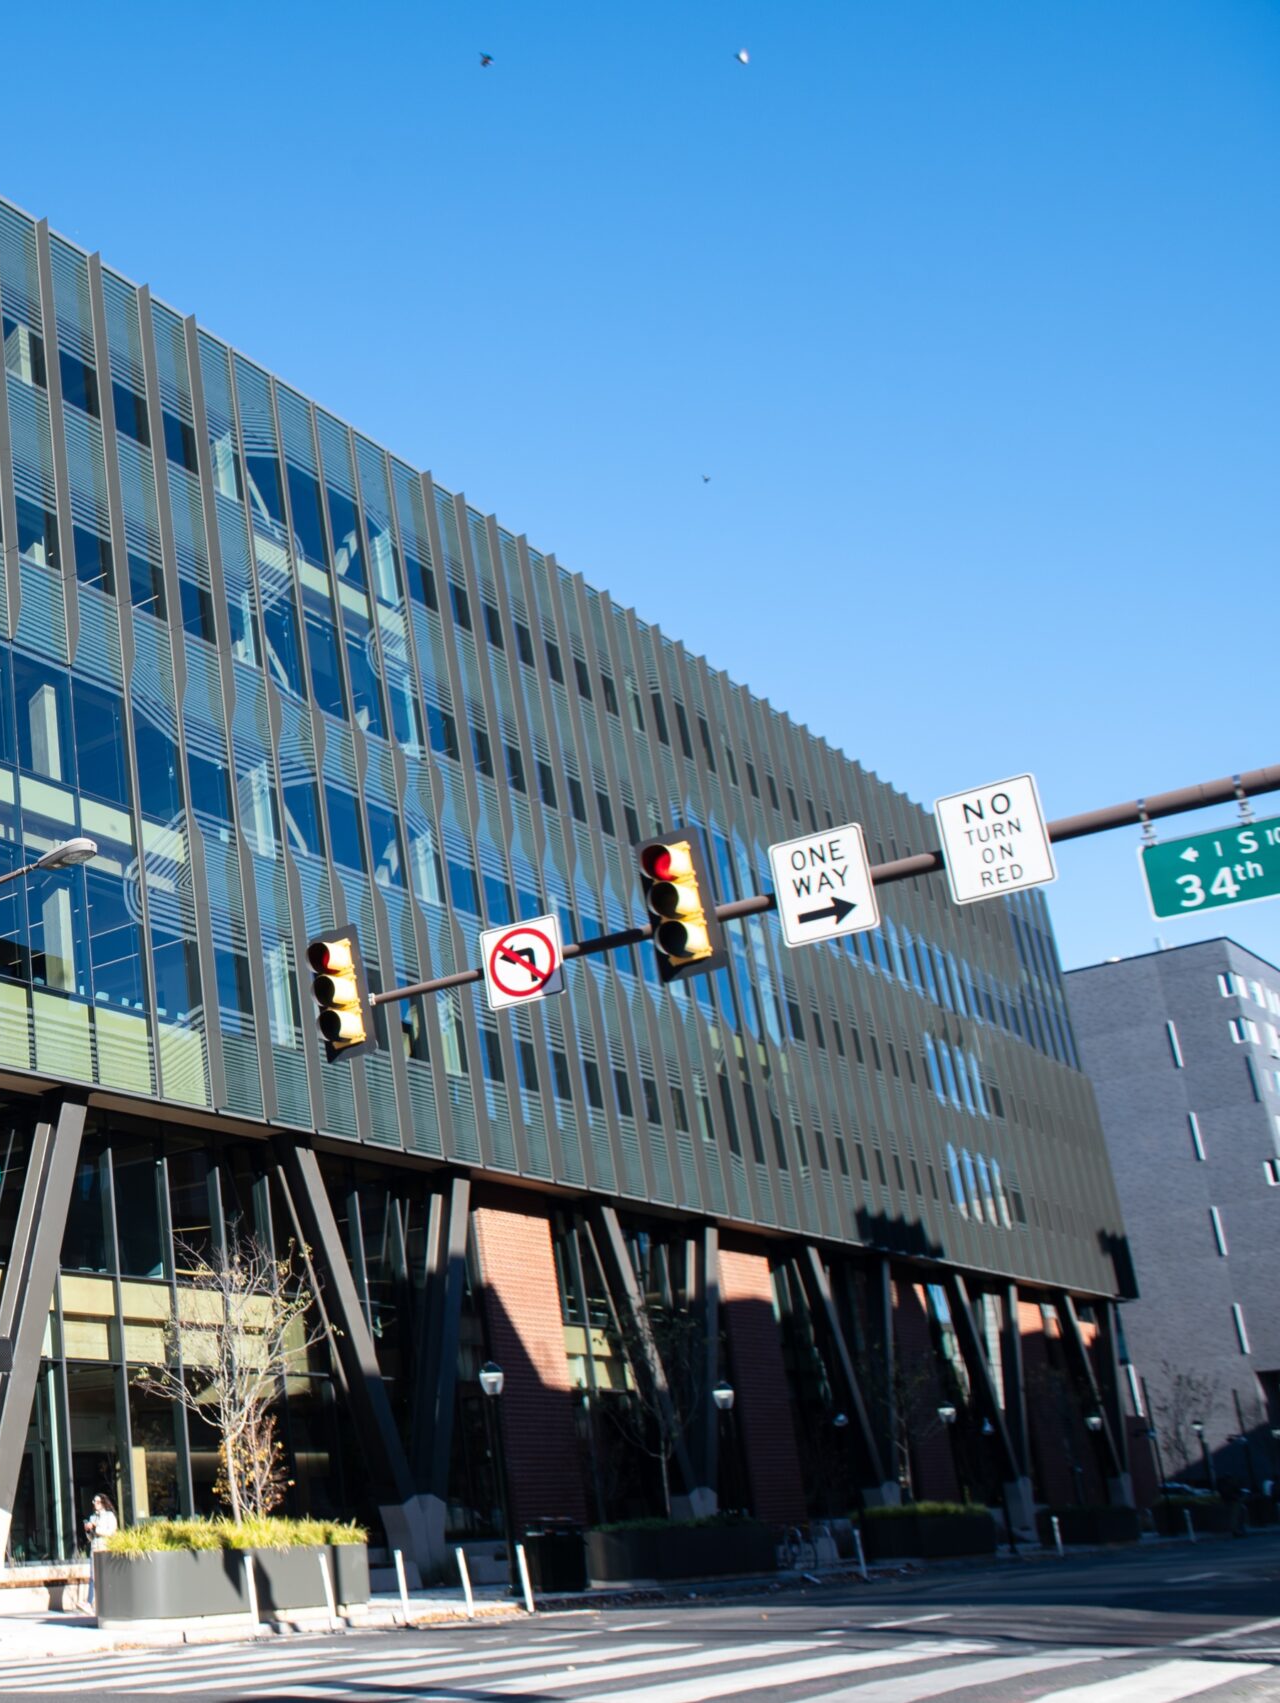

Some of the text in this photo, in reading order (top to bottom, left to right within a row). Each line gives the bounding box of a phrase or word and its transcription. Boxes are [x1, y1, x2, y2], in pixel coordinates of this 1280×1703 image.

[962, 793, 1011, 824] NO
[963, 817, 1022, 846] TURN
[1236, 831, 1259, 854] S
[791, 839, 845, 871] ONE
[982, 842, 1014, 864] ON
[792, 865, 848, 898] WAY
[980, 863, 1023, 887] RED
[1175, 860, 1264, 908] 34th
